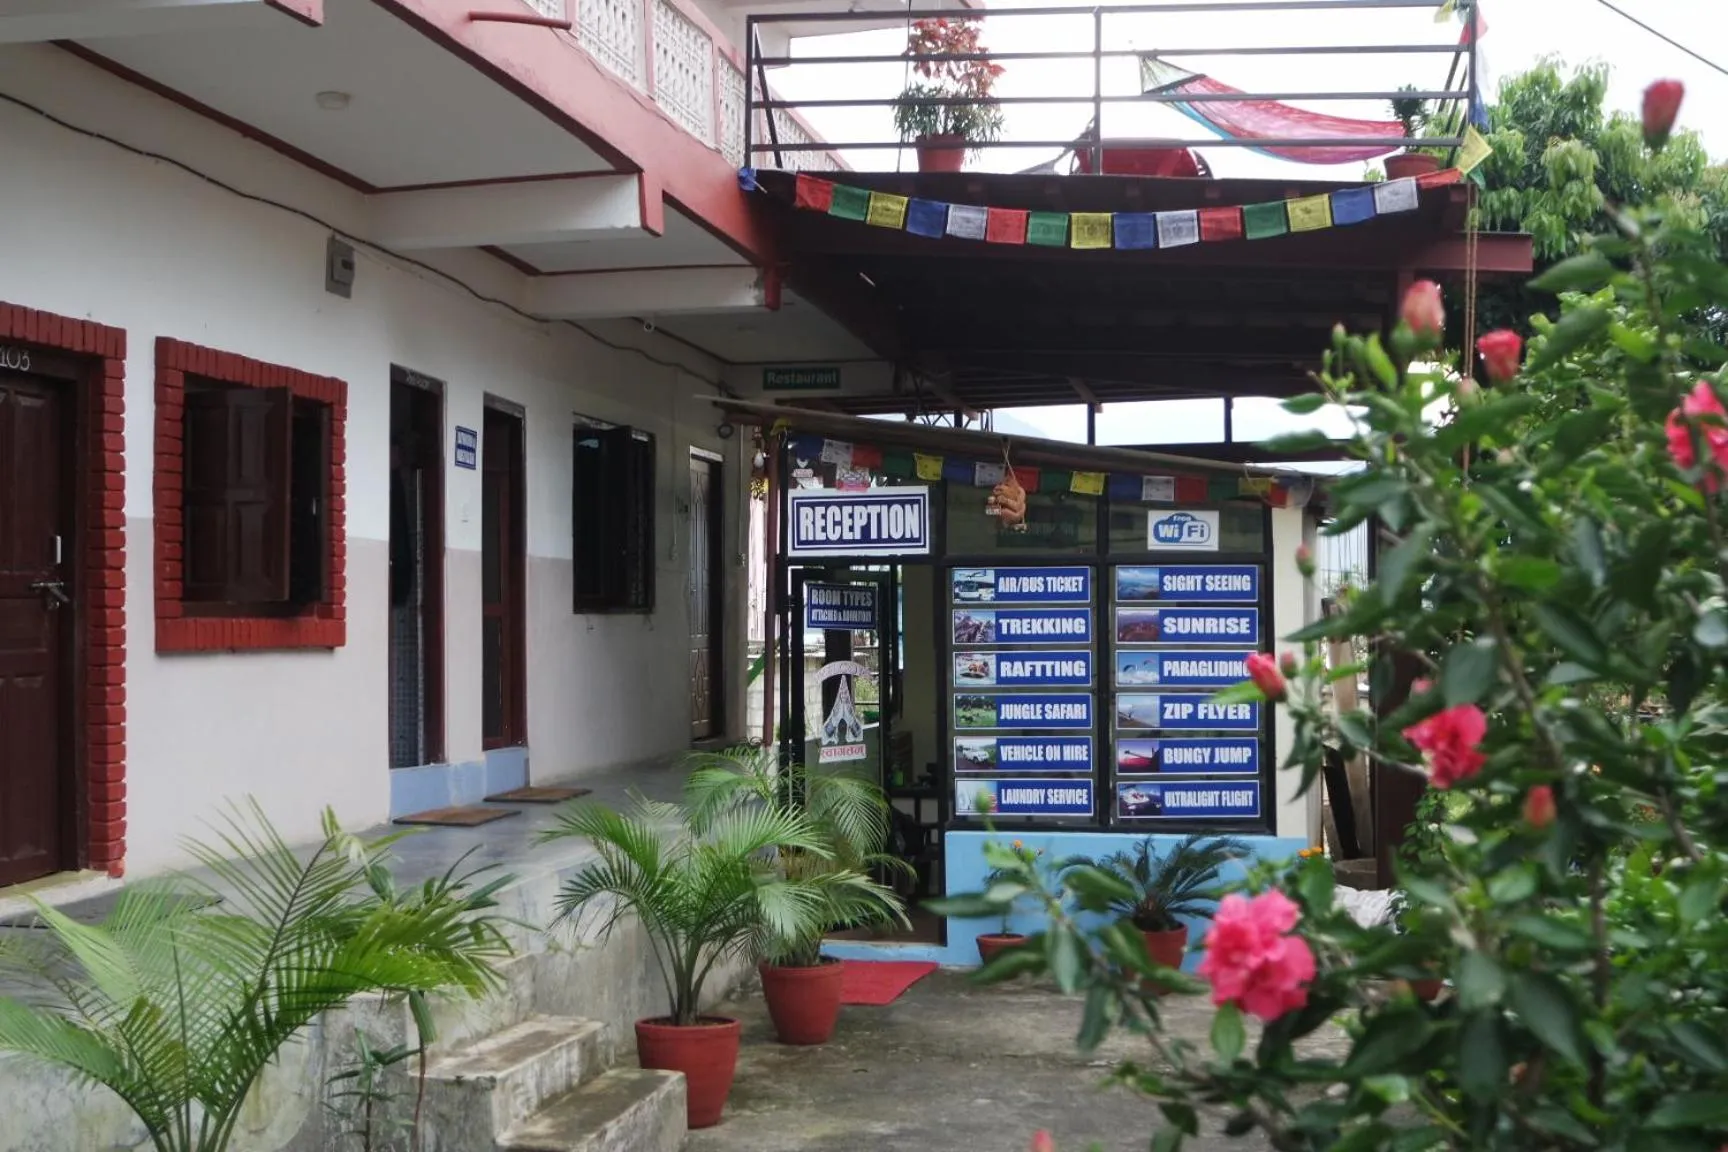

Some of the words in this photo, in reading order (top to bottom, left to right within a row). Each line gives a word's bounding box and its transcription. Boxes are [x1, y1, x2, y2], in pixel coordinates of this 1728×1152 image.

[767, 369, 837, 384] Restaurant
[799, 504, 920, 541] RECEPTION
[998, 576, 1044, 593] AIR/BUS
[1045, 576, 1084, 592] TICKET
[1162, 574, 1203, 592] SIGHT
[1205, 574, 1251, 592] SEEING
[811, 589, 841, 605] ROOM
[842, 591, 873, 607] TYPES
[999, 617, 1086, 635] TREKKING
[1163, 616, 1251, 634] SUNRISE
[1000, 660, 1086, 677] RAFTTING
[1000, 703, 1043, 720] JUNGLE
[1044, 703, 1087, 720] SAFARI
[1163, 703, 1194, 720] ZIP
[1197, 703, 1251, 720] FLYER
[1000, 744, 1044, 762] VEHICLE
[1045, 744, 1061, 761] ON
[1062, 744, 1089, 761] HIRE
[1163, 747, 1211, 764] BUNGY
[1213, 747, 1252, 764] JUMP
[1001, 788, 1046, 805] LAUNDRY
[1047, 788, 1089, 805] SERVICE
[1164, 791, 1221, 808] ULTRALIGHT
[1221, 790, 1254, 807] FLIGHT
